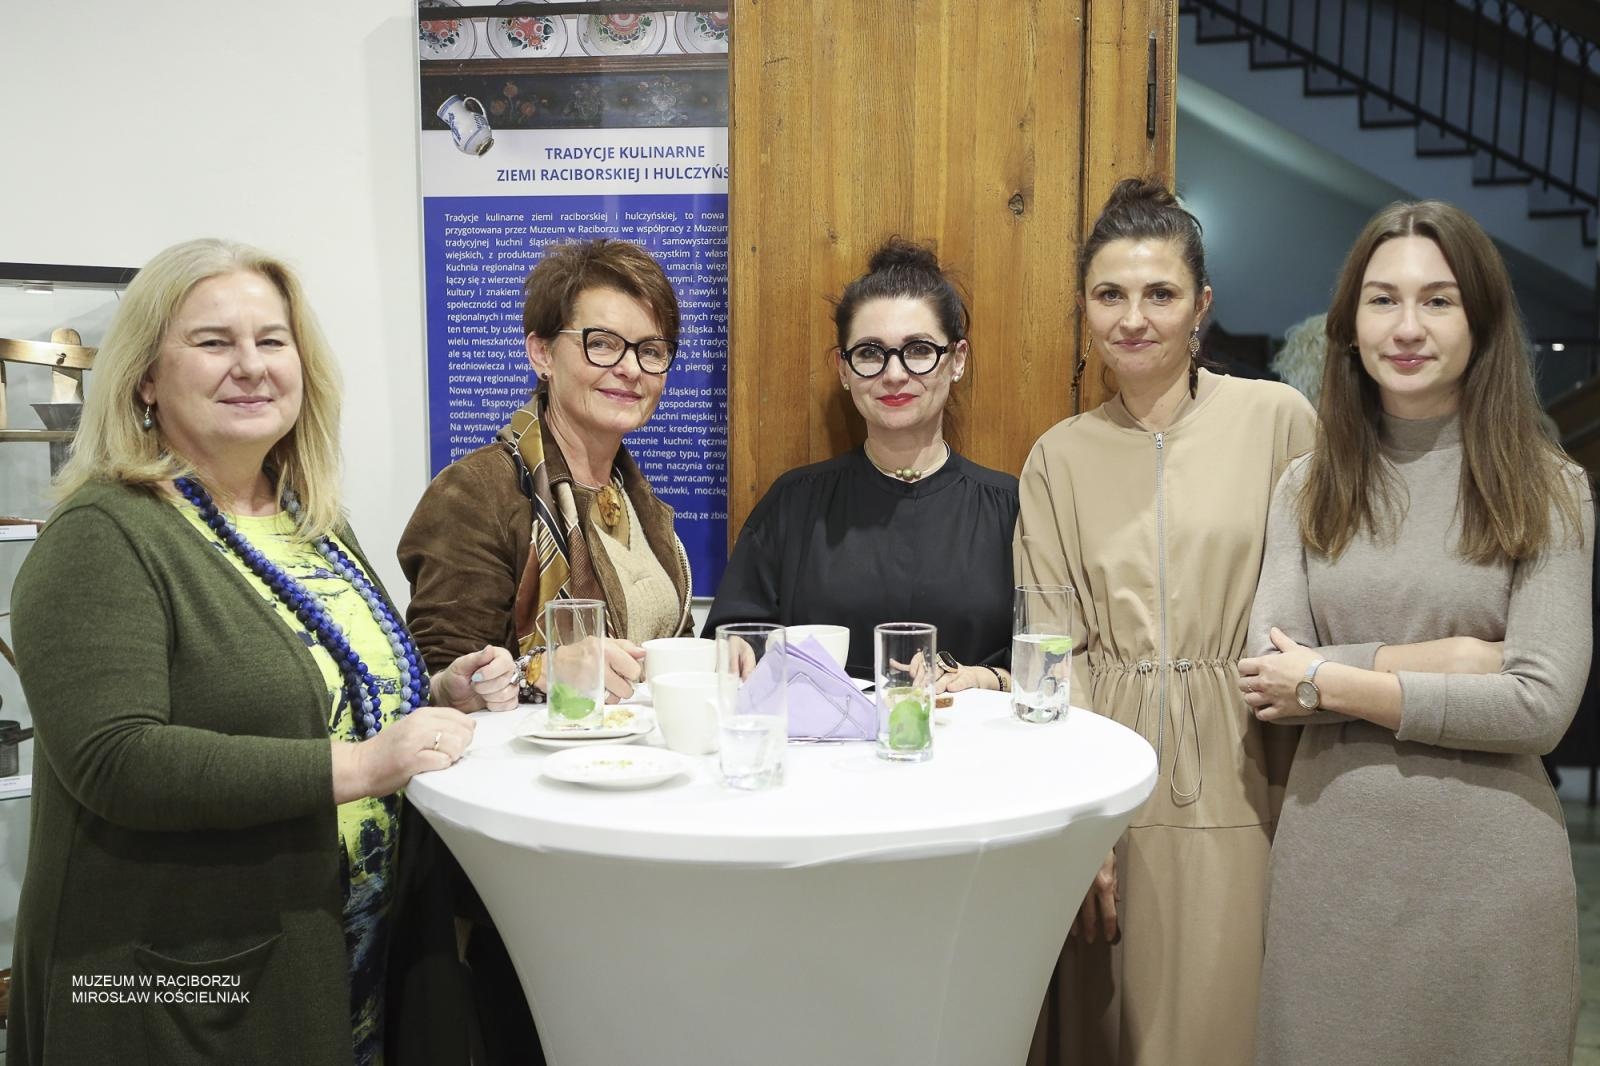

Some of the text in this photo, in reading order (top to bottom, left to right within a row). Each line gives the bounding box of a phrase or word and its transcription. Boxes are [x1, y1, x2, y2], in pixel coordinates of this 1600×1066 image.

[545, 146, 704, 162] TRADYCJE KULINARNE
[496, 169, 536, 182] ZIEMI
[541, 168, 638, 182] RACIBORSKIEJ
[645, 168, 648, 179] I
[444, 214, 478, 223] Tradycje
[486, 213, 524, 221] kulinarne
[532, 213, 553, 221] ziemi
[560, 212, 608, 222] raciborskiej
[626, 212, 677, 222] hulczyńskiej,
[445, 226, 502, 236] przygotowana
[505, 226, 526, 235] przez
[636, 225, 684, 234] współpracy
[445, 239, 489, 248] tradycyjnej
[496, 238, 522, 246] kuchni
[446, 251, 484, 260] wiejskich,
[482, 263, 524, 273] regionalna
[446, 276, 465, 286] łączy
[468, 277, 479, 285] się
[446, 288, 474, 298] kultury
[486, 288, 520, 296] znakiem
[689, 288, 718, 297] nawyki
[446, 301, 497, 310] społeczności
[677, 300, 720, 310] obserwuje
[447, 313, 498, 323] regionalnych
[680, 313, 708, 322] innych
[462, 326, 488, 334] temat,
[490, 325, 500, 335] by
[679, 338, 690, 347] się
[462, 351, 471, 359] są
[488, 351, 506, 359] tacy,
[703, 350, 726, 358] kluski
[448, 362, 504, 370] średniowiecza
[685, 363, 714, 372] pierogi
[449, 375, 481, 384] potrawą
[474, 388, 508, 396] wystawa
[668, 388, 698, 397] śląskiej
[659, 400, 712, 409] gospodarstw
[450, 411, 500, 421] codziennego
[681, 412, 717, 422] miejskiej
[669, 425, 707, 434] kredensy
[450, 435, 486, 444] okresów,
[643, 448, 676, 459] różnego
[680, 450, 700, 459] typu,
[667, 462, 702, 471] naczynia
[673, 475, 714, 484] zwracamy
